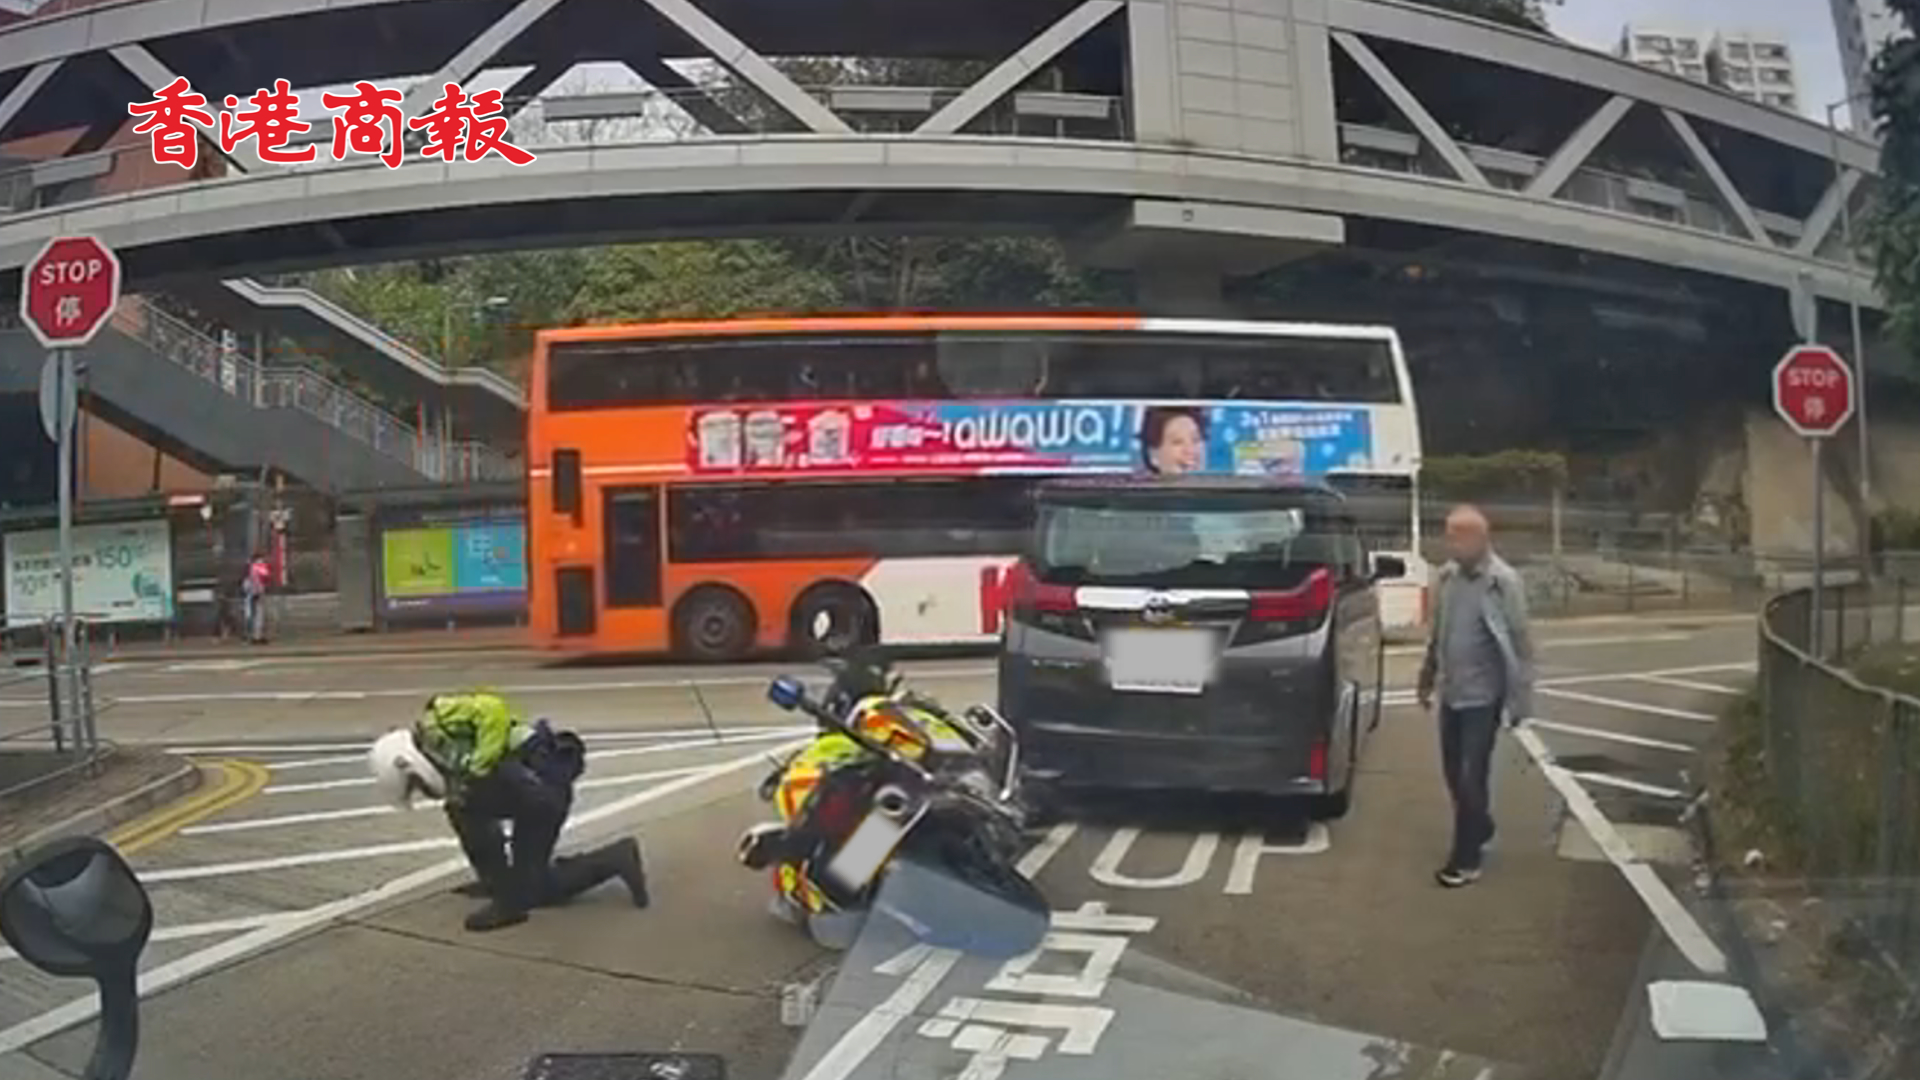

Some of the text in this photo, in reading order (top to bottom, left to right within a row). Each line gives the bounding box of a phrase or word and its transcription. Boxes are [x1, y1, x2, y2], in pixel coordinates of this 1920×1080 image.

[39, 258, 102, 286] STOP
[55, 295, 82, 327] 停
[1786, 366, 1841, 389] STOP
